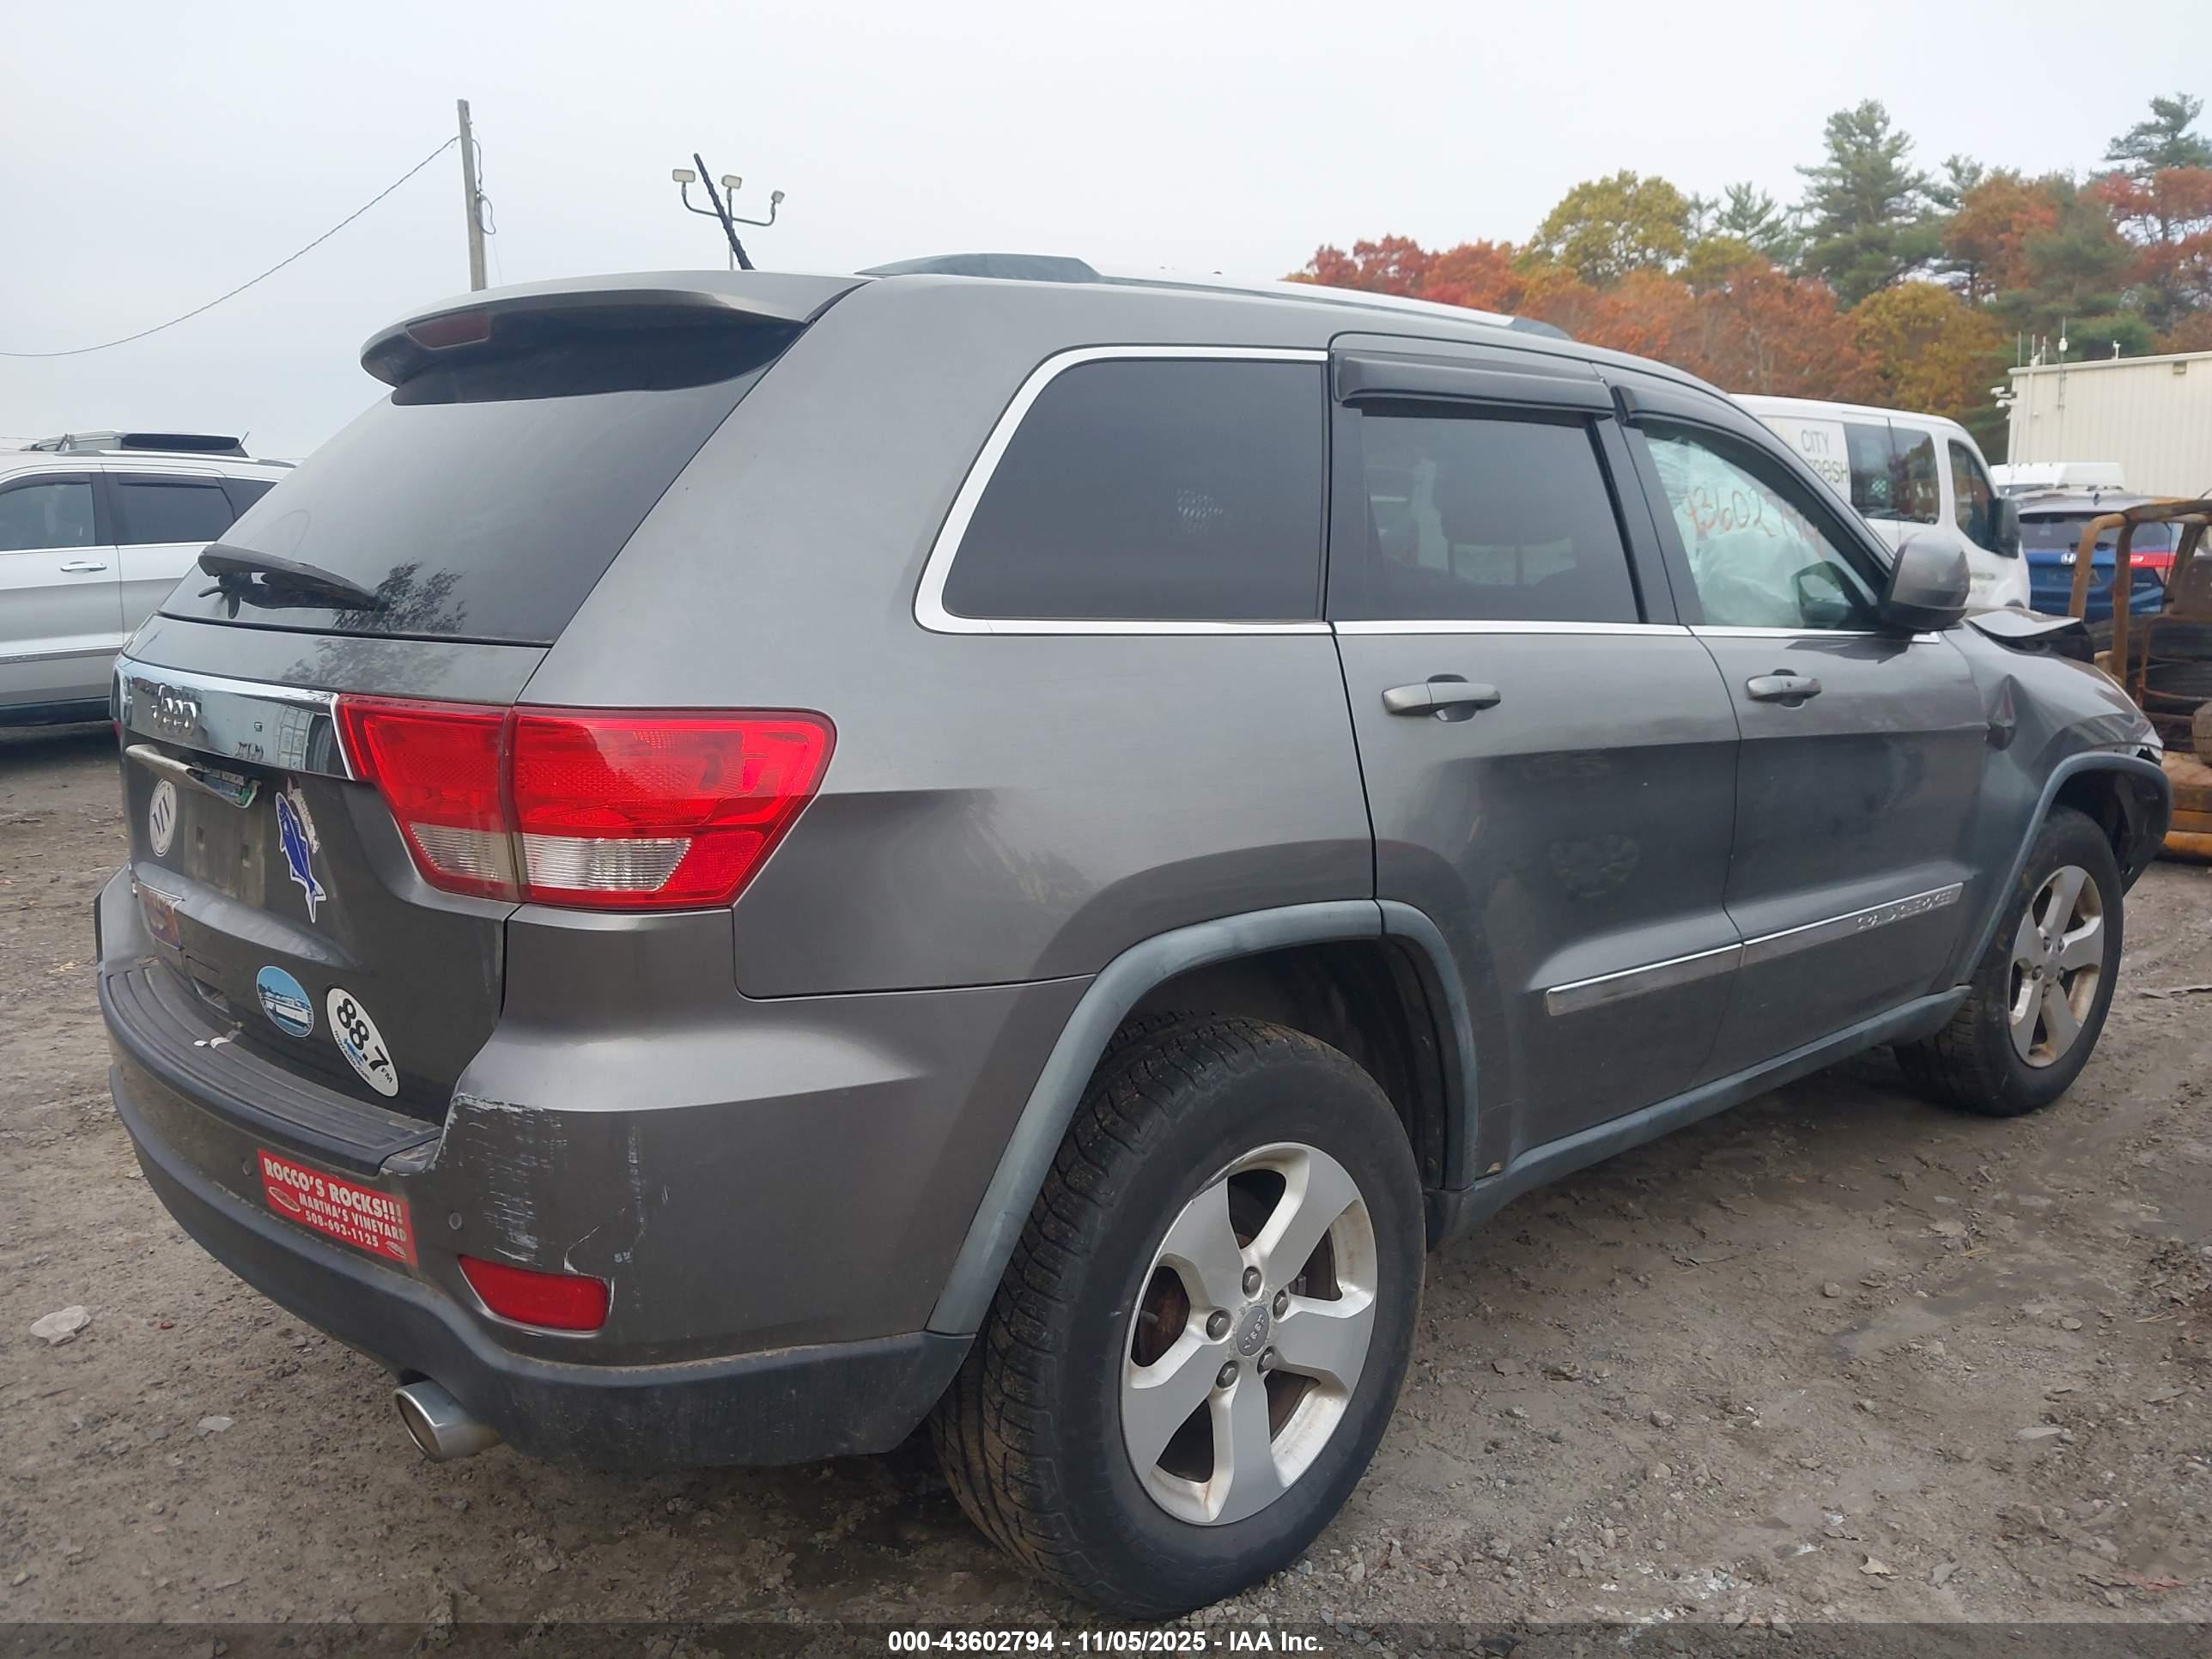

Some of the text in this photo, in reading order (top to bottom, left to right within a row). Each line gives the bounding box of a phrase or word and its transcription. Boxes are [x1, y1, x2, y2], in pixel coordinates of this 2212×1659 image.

[1802, 429, 1829, 453] CITY
[150, 684, 198, 730] Jeep
[336, 998, 390, 1073] 88.7
[263, 1158, 325, 1198] ROCCO'S
[327, 1182, 404, 1224] ROCKS!!!
[299, 1192, 349, 1223] MARTHA'S
[351, 1212, 407, 1242] VINEYARD
[305, 1210, 380, 1248] 508-693-1125
[1243, 1313, 1265, 1350] Jeep
